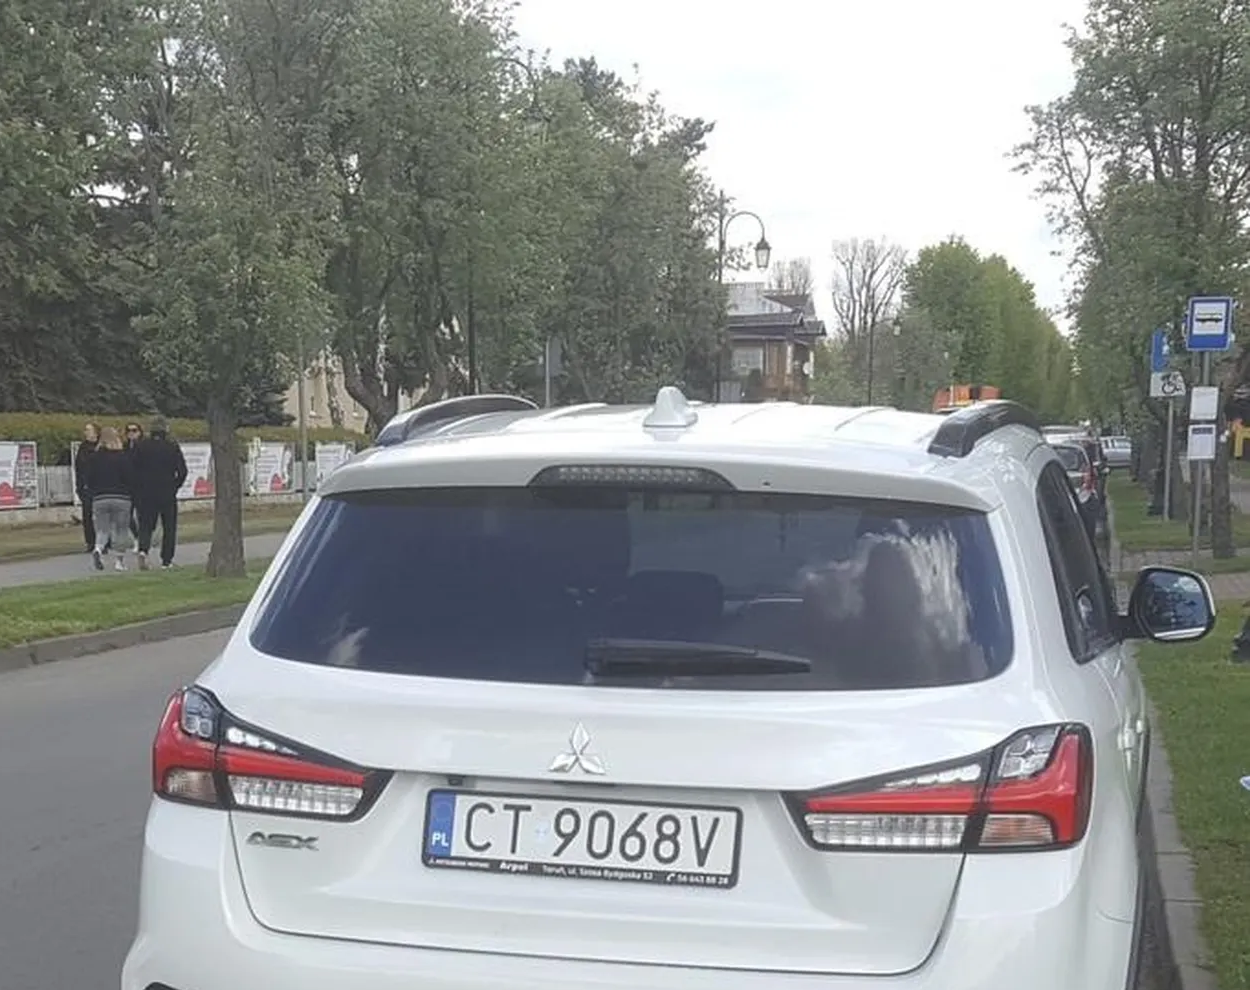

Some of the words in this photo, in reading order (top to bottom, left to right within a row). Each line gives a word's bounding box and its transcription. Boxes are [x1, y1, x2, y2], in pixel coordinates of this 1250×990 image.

[245, 831, 320, 852] ASX
[431, 831, 450, 848] PL
[464, 802, 533, 855] CT
[552, 807, 721, 868] 9068V
